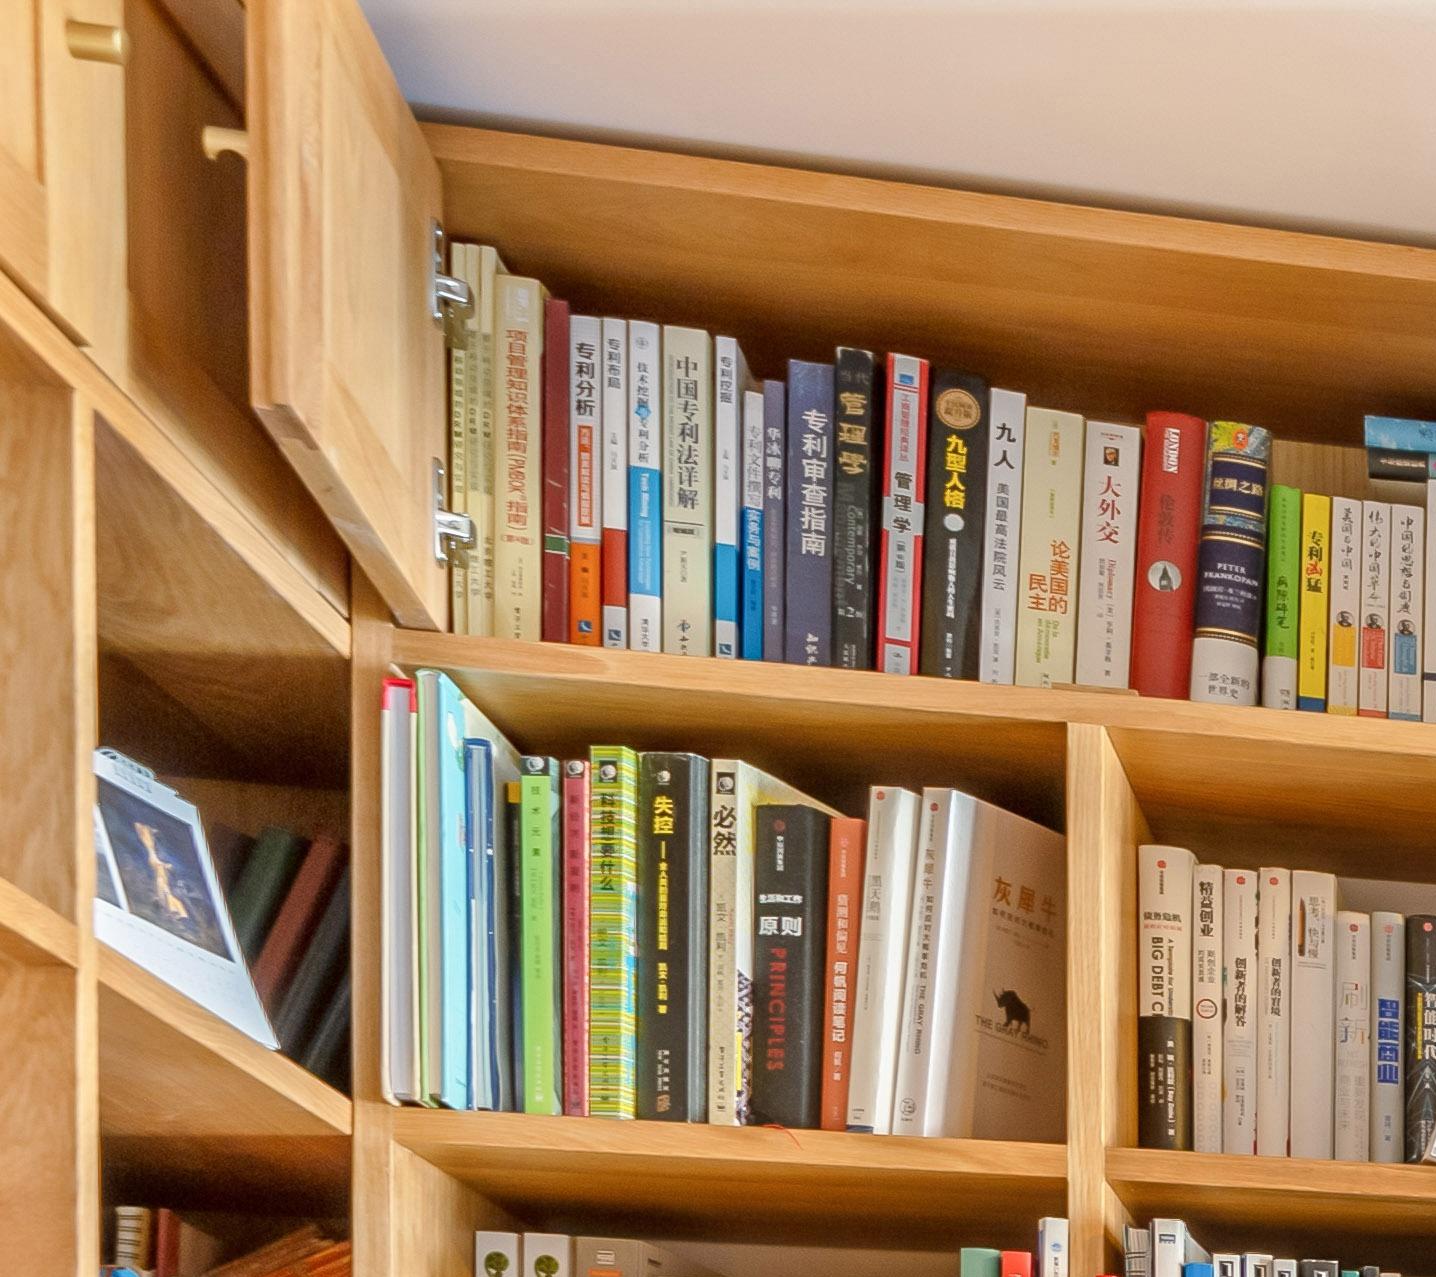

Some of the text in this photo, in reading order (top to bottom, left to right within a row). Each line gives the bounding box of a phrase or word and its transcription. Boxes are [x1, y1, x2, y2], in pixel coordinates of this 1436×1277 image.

[575, 342, 596, 417] 专利分析
[676, 356, 699, 511] 中国专利法详解
[993, 422, 1016, 471] 九人
[1165, 427, 1181, 475] LONDON
[800, 409, 828, 557] 专利审查指南
[892, 471, 913, 533] 管理学
[944, 434, 968, 510] 九型人格
[1097, 475, 1121, 545] 大外交
[1027, 540, 1071, 614] 论美国的 民主
[653, 795, 674, 834] 失控
[713, 805, 737, 855] 必然
[759, 916, 802, 937] 原则
[1198, 880, 1214, 937] 精益创业
[1149, 936, 1163, 1004] BIG DEBT
[767, 947, 786, 1072] PRINCIPLES
[976, 1015, 993, 1030] THE
[995, 1020, 1020, 1040] GRAY
